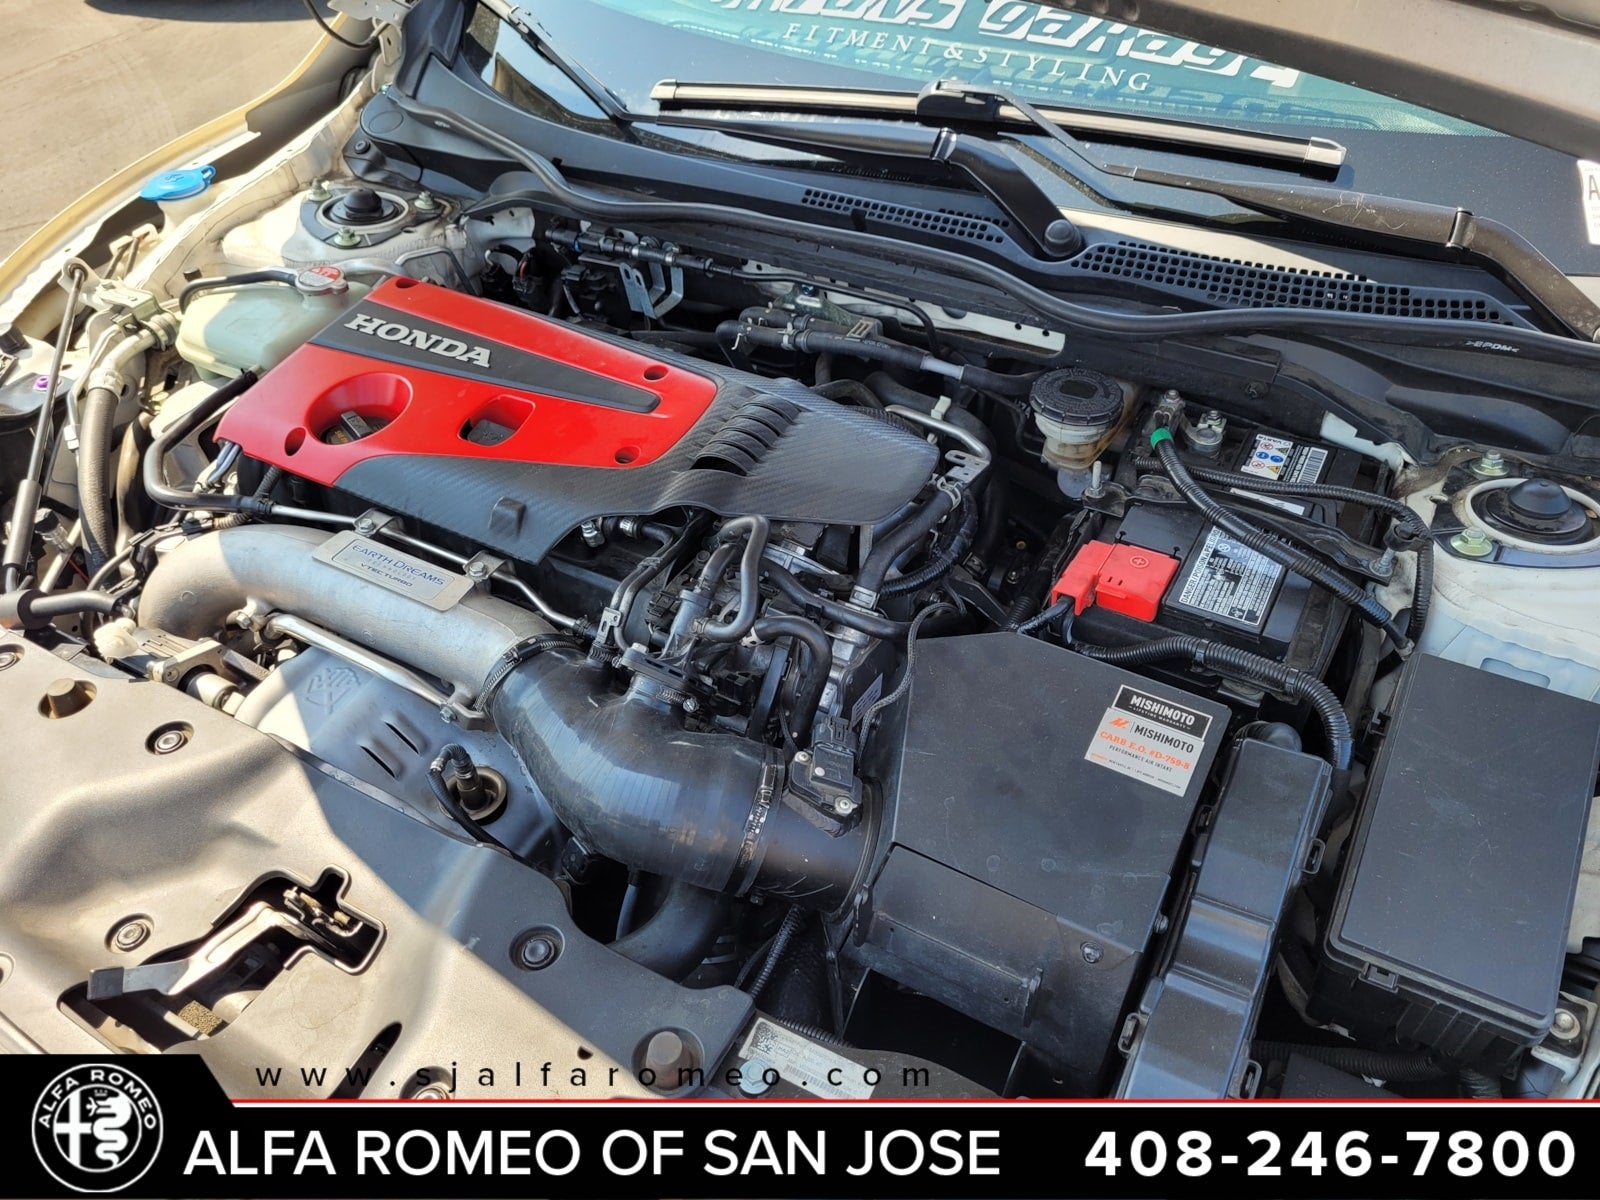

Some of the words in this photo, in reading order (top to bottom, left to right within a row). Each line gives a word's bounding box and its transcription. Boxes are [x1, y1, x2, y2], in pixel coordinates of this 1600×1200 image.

[344, 313, 492, 368] HONDA
[352, 544, 393, 565] EARTH
[393, 561, 446, 586] DREAMS
[360, 563, 385, 577] VTEC
[384, 573, 413, 587] TURBO
[1130, 694, 1195, 726] MISHIMOTO
[1157, 716, 1187, 729] WARRANTY
[1099, 731, 1128, 746] CARB
[1134, 724, 1194, 754] MISHIMOTO
[1109, 745, 1144, 762] PERFORMANCE
[1145, 756, 1154, 765] AIR
